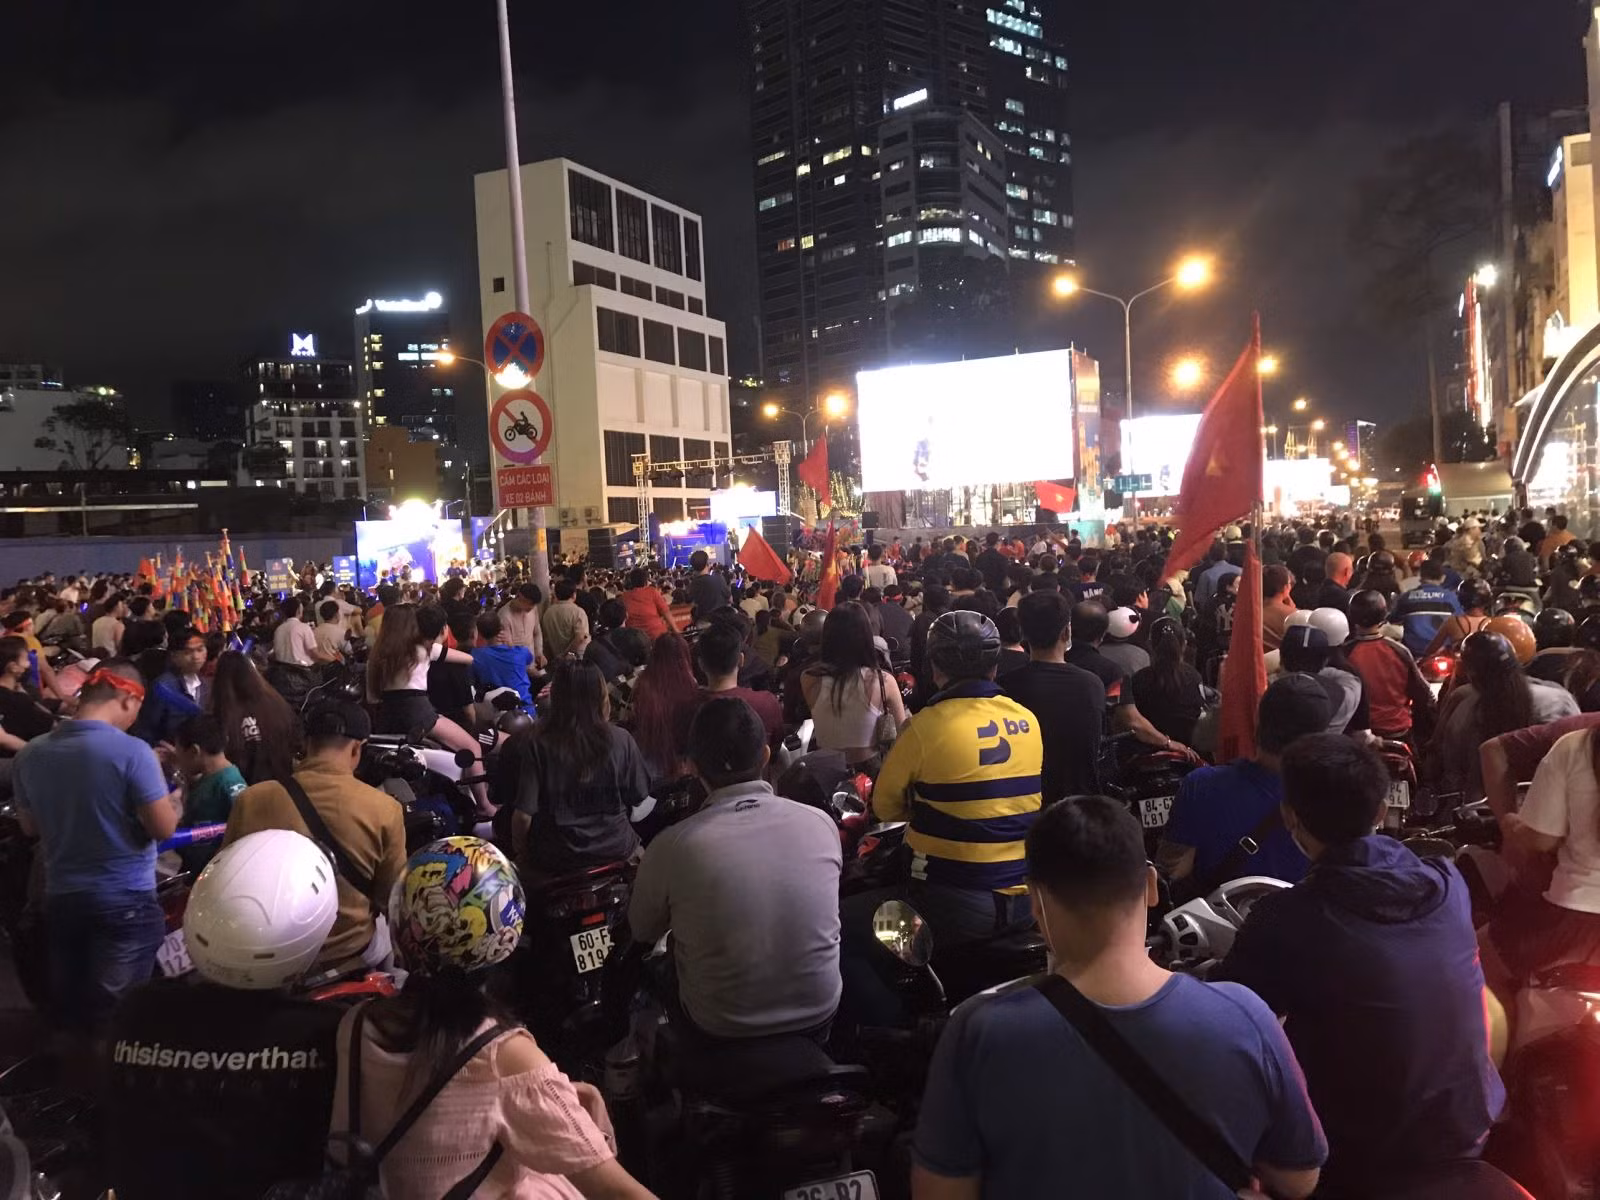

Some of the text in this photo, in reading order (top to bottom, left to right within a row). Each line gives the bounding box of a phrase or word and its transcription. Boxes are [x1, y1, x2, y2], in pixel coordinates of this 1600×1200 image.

[516, 470, 531, 485] CÁC
[505, 489, 546, 504] XE 02 BÁNH
[1002, 717, 1030, 736] be
